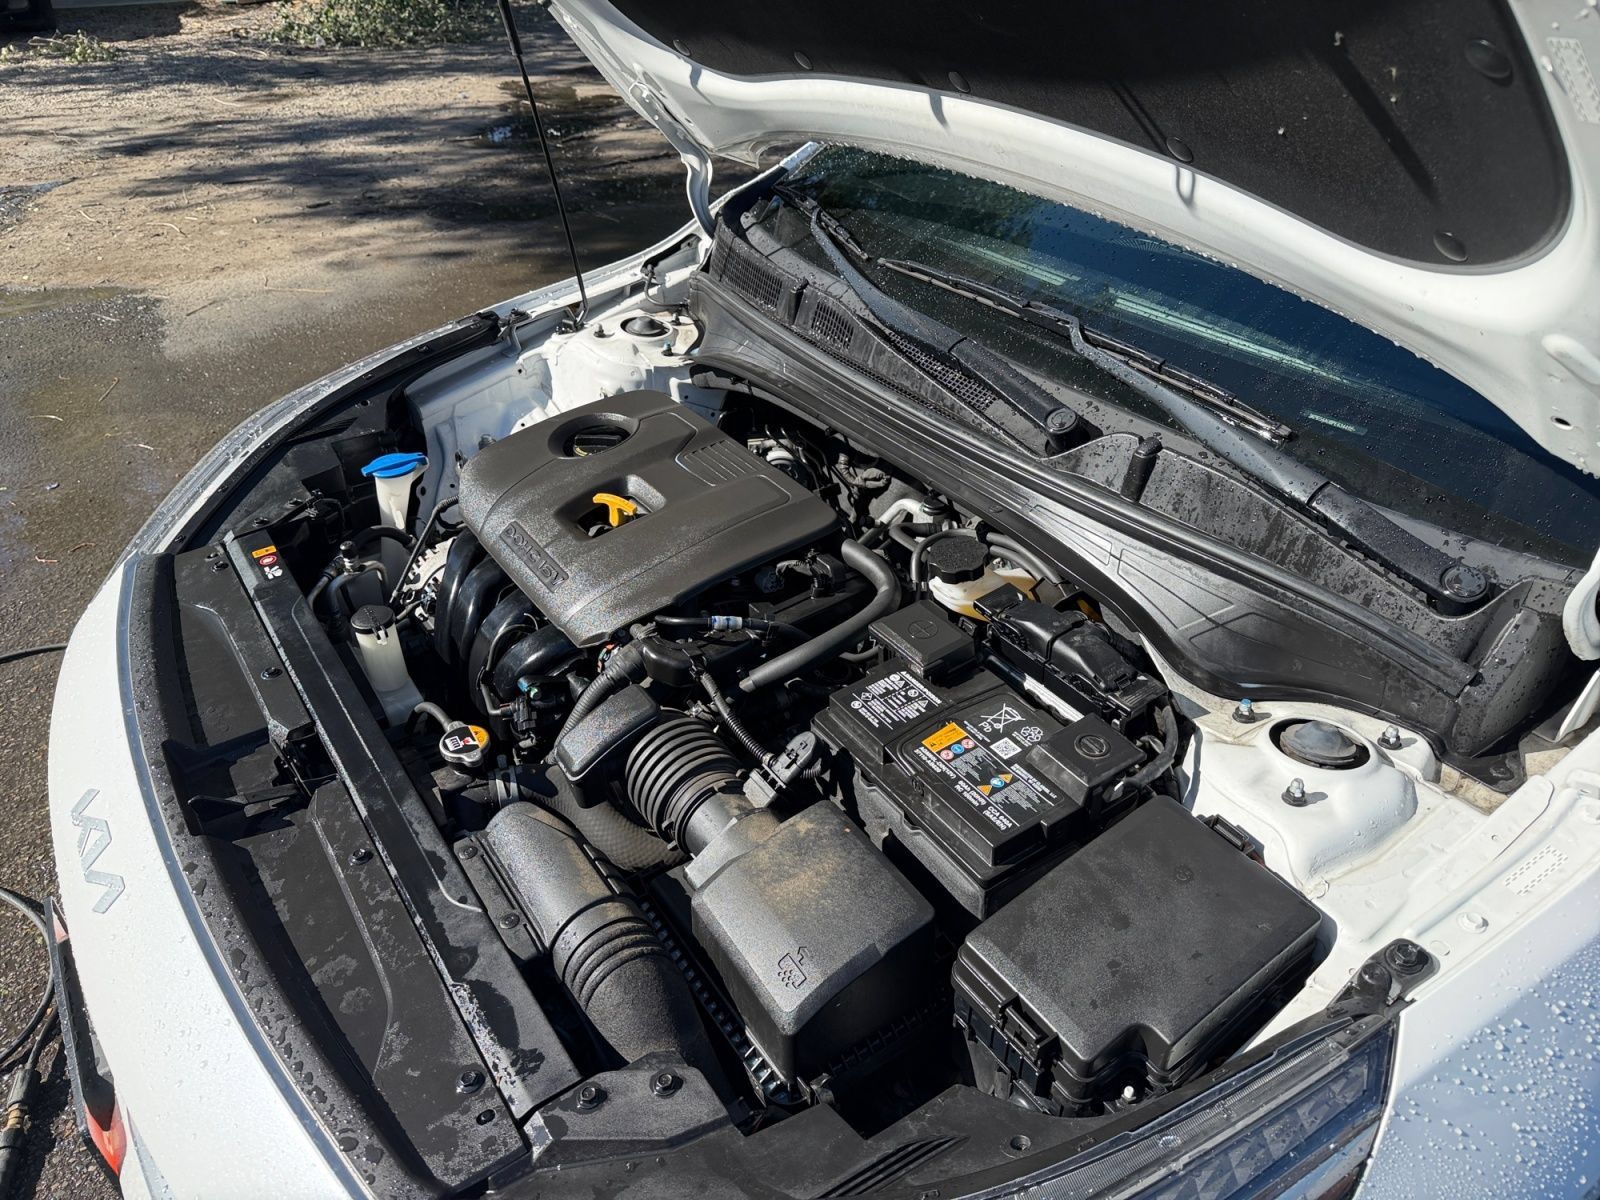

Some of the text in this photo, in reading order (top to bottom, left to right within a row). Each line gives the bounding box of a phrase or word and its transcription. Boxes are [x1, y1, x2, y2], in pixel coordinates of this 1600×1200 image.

[505, 523, 541, 563] DOHC
[977, 721, 992, 732] Pb
[953, 784, 964, 792] RC
[987, 805, 999, 816] CCA
